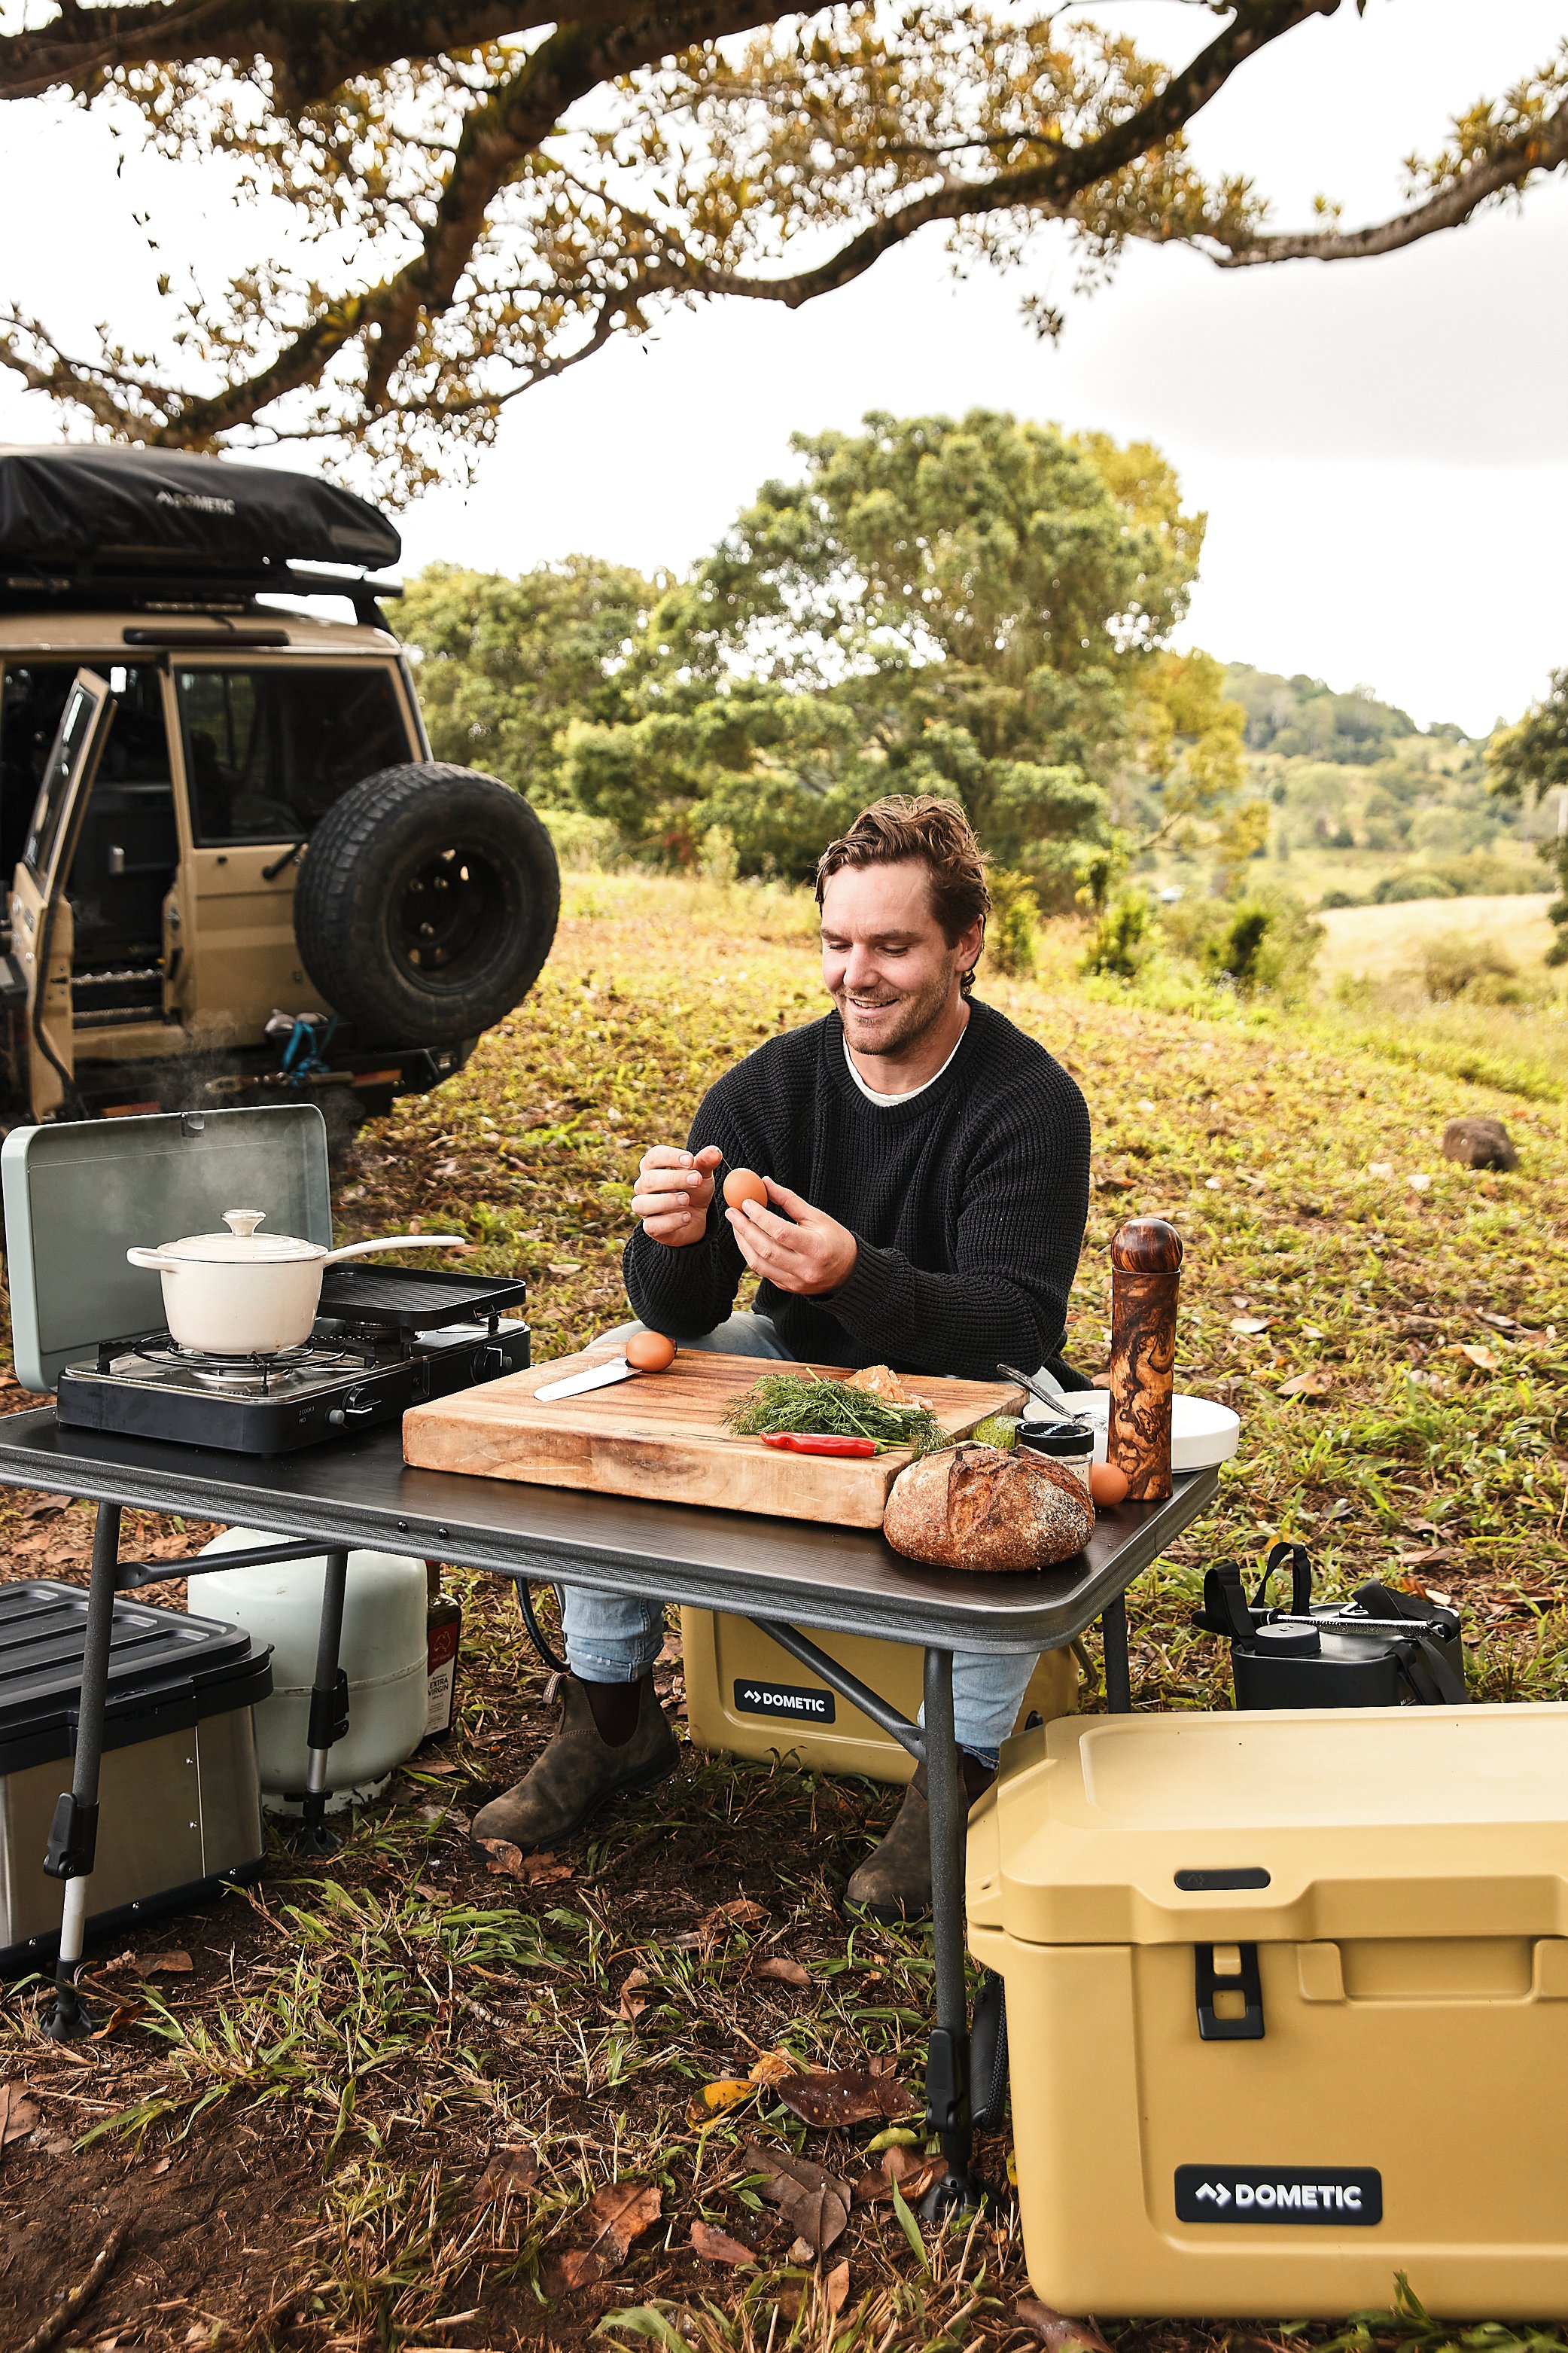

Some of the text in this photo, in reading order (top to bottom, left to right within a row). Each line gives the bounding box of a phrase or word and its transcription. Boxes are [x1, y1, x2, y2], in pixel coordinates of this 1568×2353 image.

[428, 1683, 449, 1696] VIRGIN
[429, 1677, 449, 1689] EXTRA
[763, 1692, 825, 1712] DOMETIC
[1235, 2184, 1362, 2208] DOMETIC
